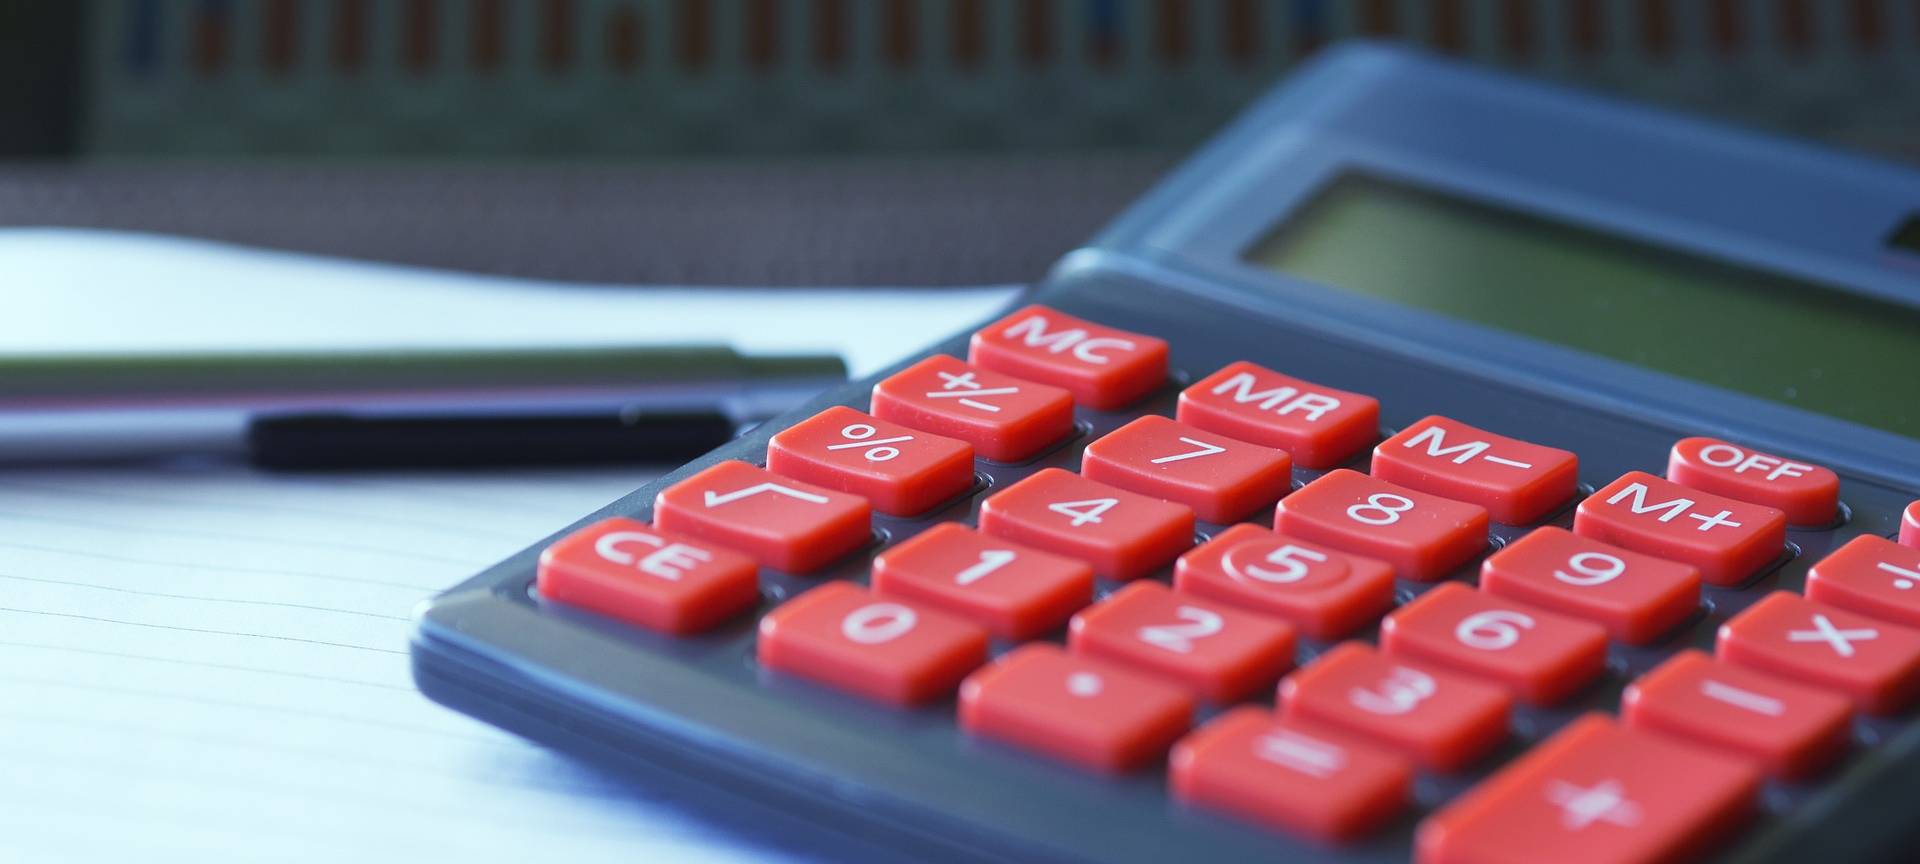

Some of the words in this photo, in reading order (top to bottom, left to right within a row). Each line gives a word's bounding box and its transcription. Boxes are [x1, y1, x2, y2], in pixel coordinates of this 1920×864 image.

[1003, 316, 1135, 366] MC
[1212, 372, 1341, 423] MR
[1149, 436, 1227, 468] 7
[1698, 443, 1815, 482] OFF
[1046, 497, 1121, 527] 4
[1345, 492, 1416, 526] 8
[1605, 481, 1743, 533] M+
[593, 529, 713, 582] CE
[954, 549, 1017, 586] 1
[1245, 545, 1327, 584] 5
[1552, 551, 1627, 586] 9
[839, 602, 919, 645] 0
[1137, 605, 1226, 656] 2
[1453, 609, 1536, 651] 6
[1350, 666, 1437, 716] 3
